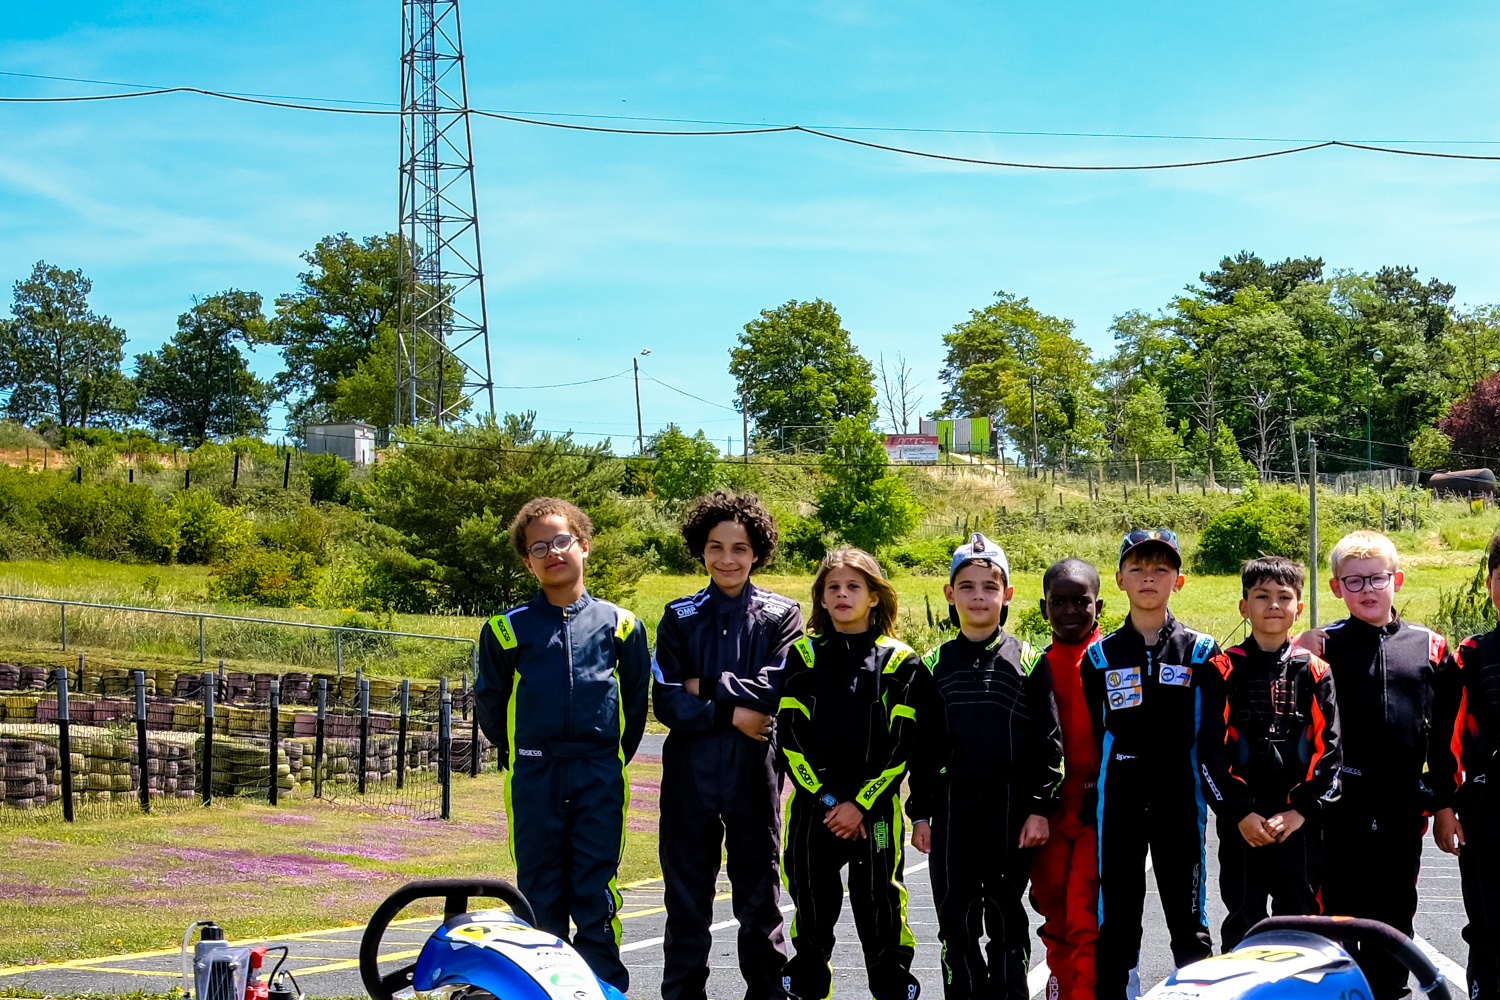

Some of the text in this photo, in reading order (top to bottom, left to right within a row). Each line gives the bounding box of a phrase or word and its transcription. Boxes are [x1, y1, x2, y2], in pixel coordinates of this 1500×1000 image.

[676, 606, 697, 618] OMP
[496, 619, 511, 643] sparco
[862, 776, 888, 801] sparco
